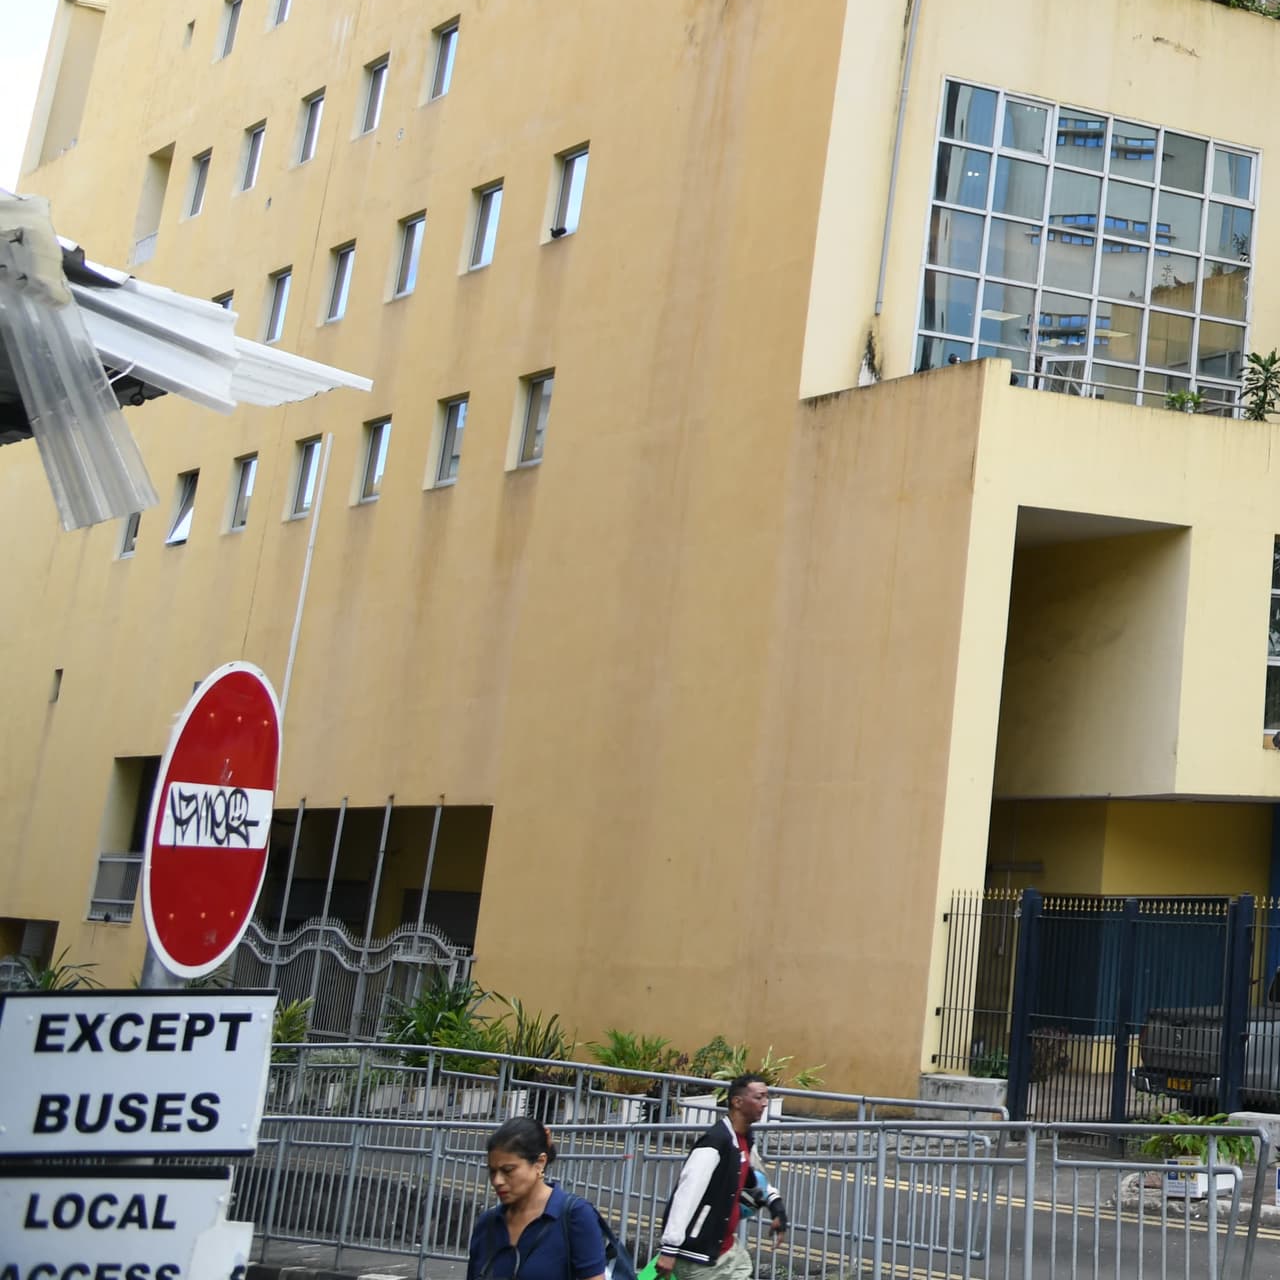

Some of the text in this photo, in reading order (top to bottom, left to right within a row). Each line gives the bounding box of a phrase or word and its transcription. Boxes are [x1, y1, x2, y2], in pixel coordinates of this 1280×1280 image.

[34, 1012, 252, 1053] EXCEPT
[33, 1092, 220, 1134] BUSES
[24, 1193, 176, 1230] LOCAL
